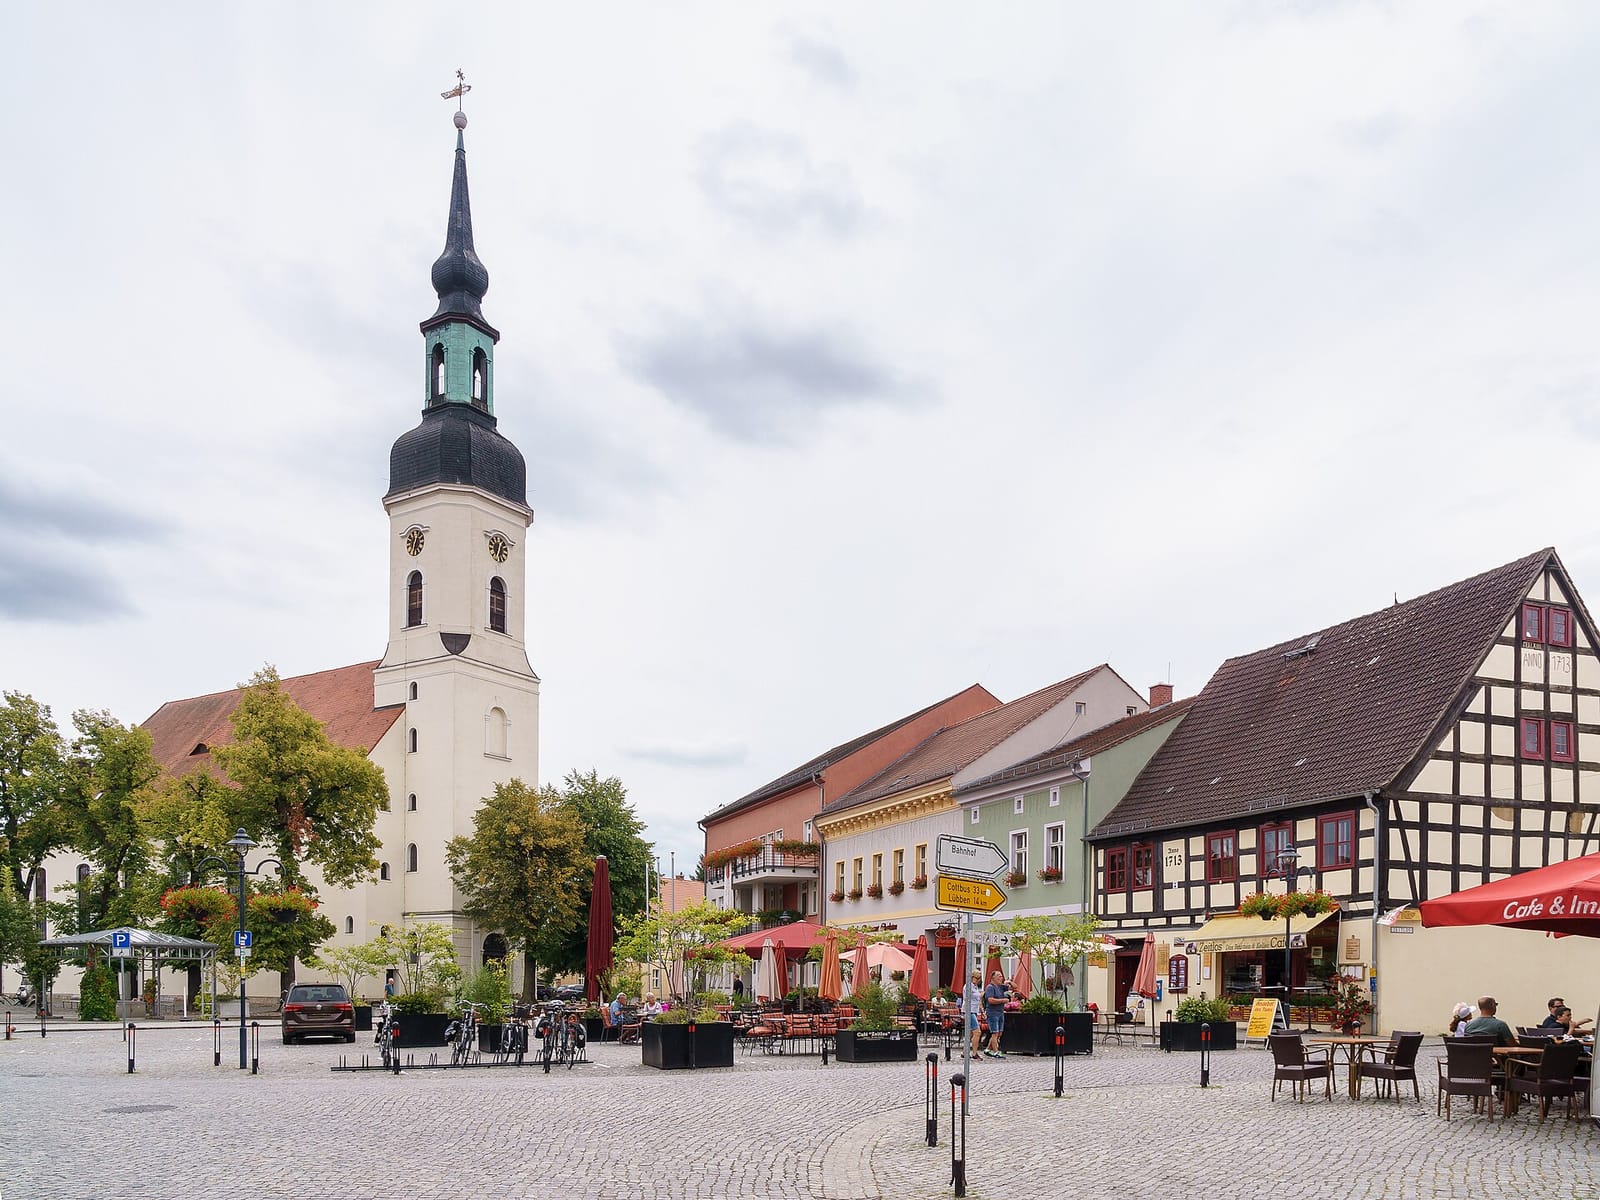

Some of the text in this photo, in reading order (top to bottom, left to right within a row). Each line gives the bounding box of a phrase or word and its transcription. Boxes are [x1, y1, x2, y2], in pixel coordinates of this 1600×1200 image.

[1523, 652, 1571, 674] ANNO 1713
[951, 844, 977, 857] Bahnhof
[1165, 854, 1183, 867] 1713
[972, 885, 980, 895] 33
[948, 893, 971, 904] Lübben
[973, 896, 980, 905] 14
[1503, 894, 1600, 920] Cafe & Im
[116, 934, 126, 947] P
[1199, 942, 1223, 953] Zeitlos
[1270, 936, 1287, 948] Caf
